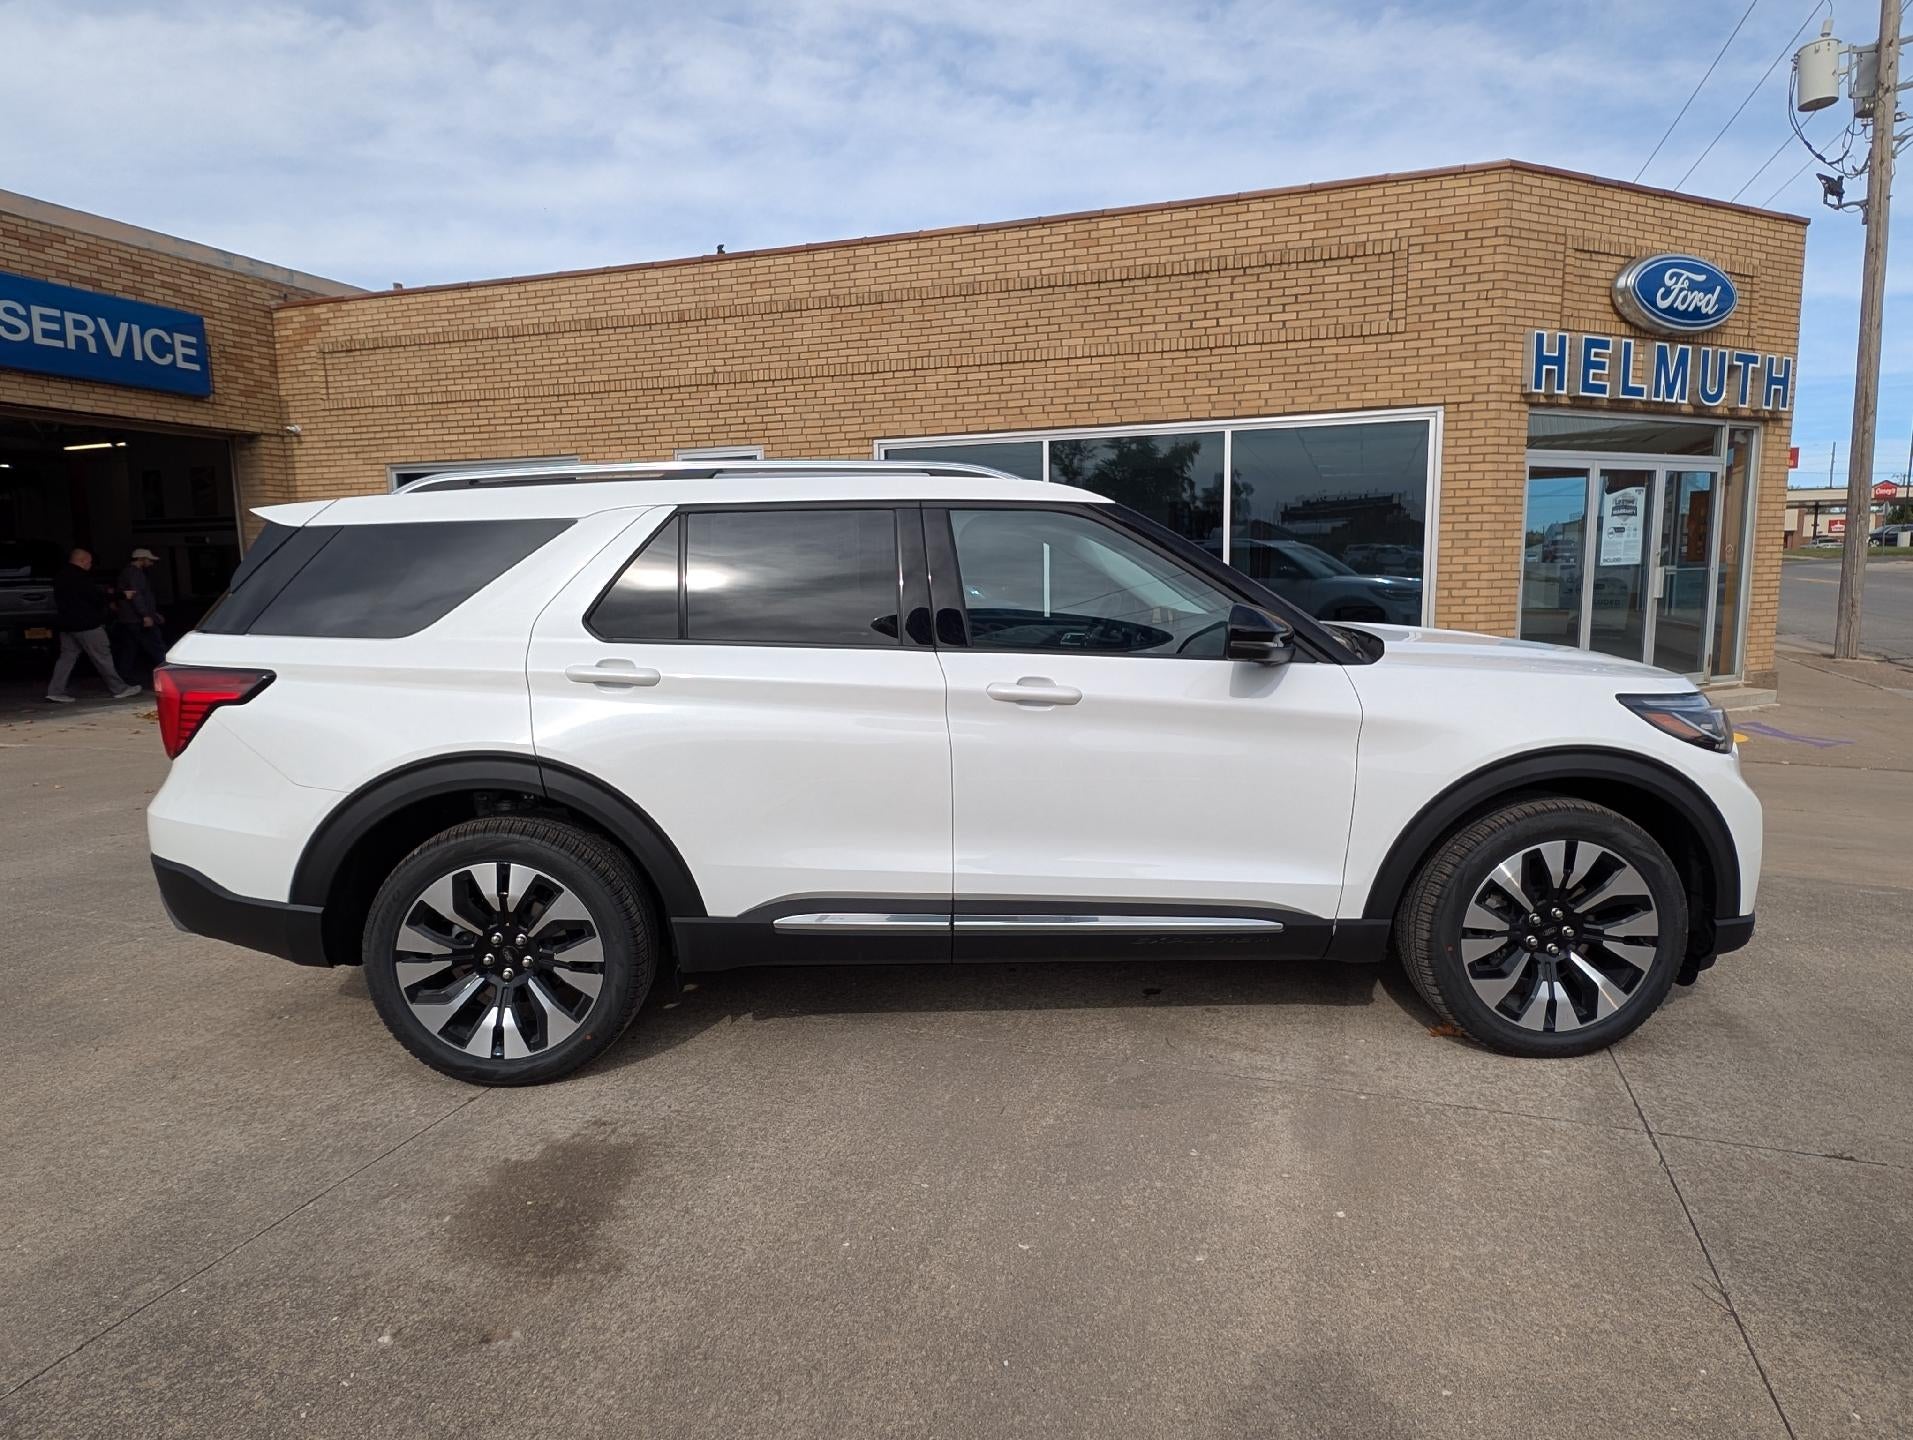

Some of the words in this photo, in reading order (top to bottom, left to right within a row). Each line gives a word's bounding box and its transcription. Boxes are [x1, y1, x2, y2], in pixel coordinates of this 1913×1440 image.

[1656, 268, 1721, 315] Ford
[0, 300, 201, 371] SERVICE
[1532, 329, 1793, 411] HELMUTH
